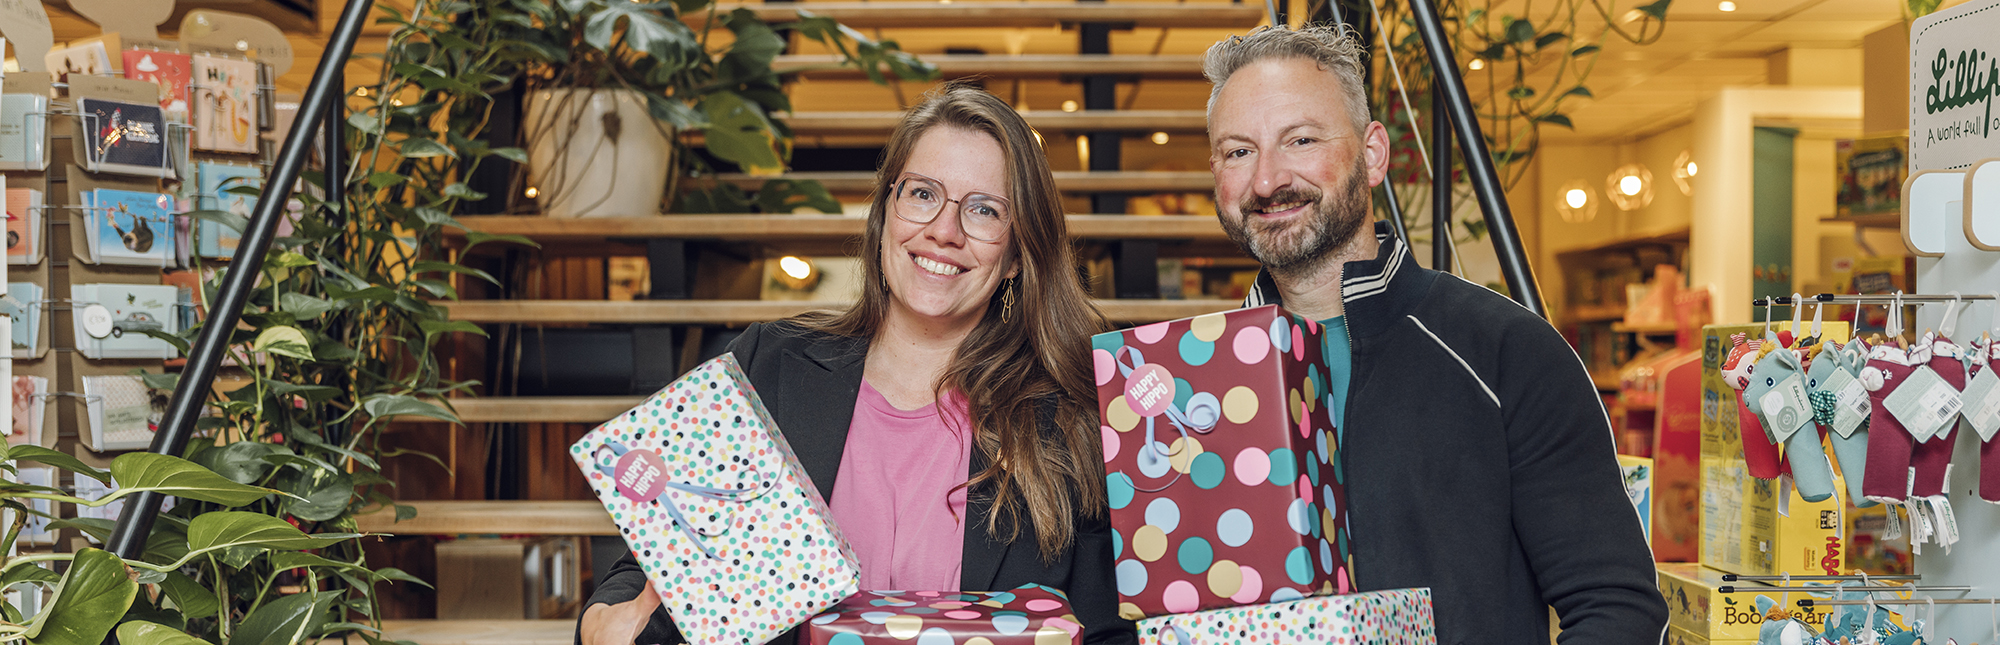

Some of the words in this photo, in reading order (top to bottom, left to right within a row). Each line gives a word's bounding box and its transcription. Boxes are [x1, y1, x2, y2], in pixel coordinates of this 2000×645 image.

[1926, 128, 1936, 148] A
[1937, 120, 1961, 141] world
[1963, 116, 1981, 138] full
[1129, 369, 1160, 401] HAPPY
[1139, 382, 1168, 411] HIPPO
[619, 453, 649, 488] HAPPY
[632, 465, 661, 497] HIPPO
[1821, 536, 1841, 576] HABA
